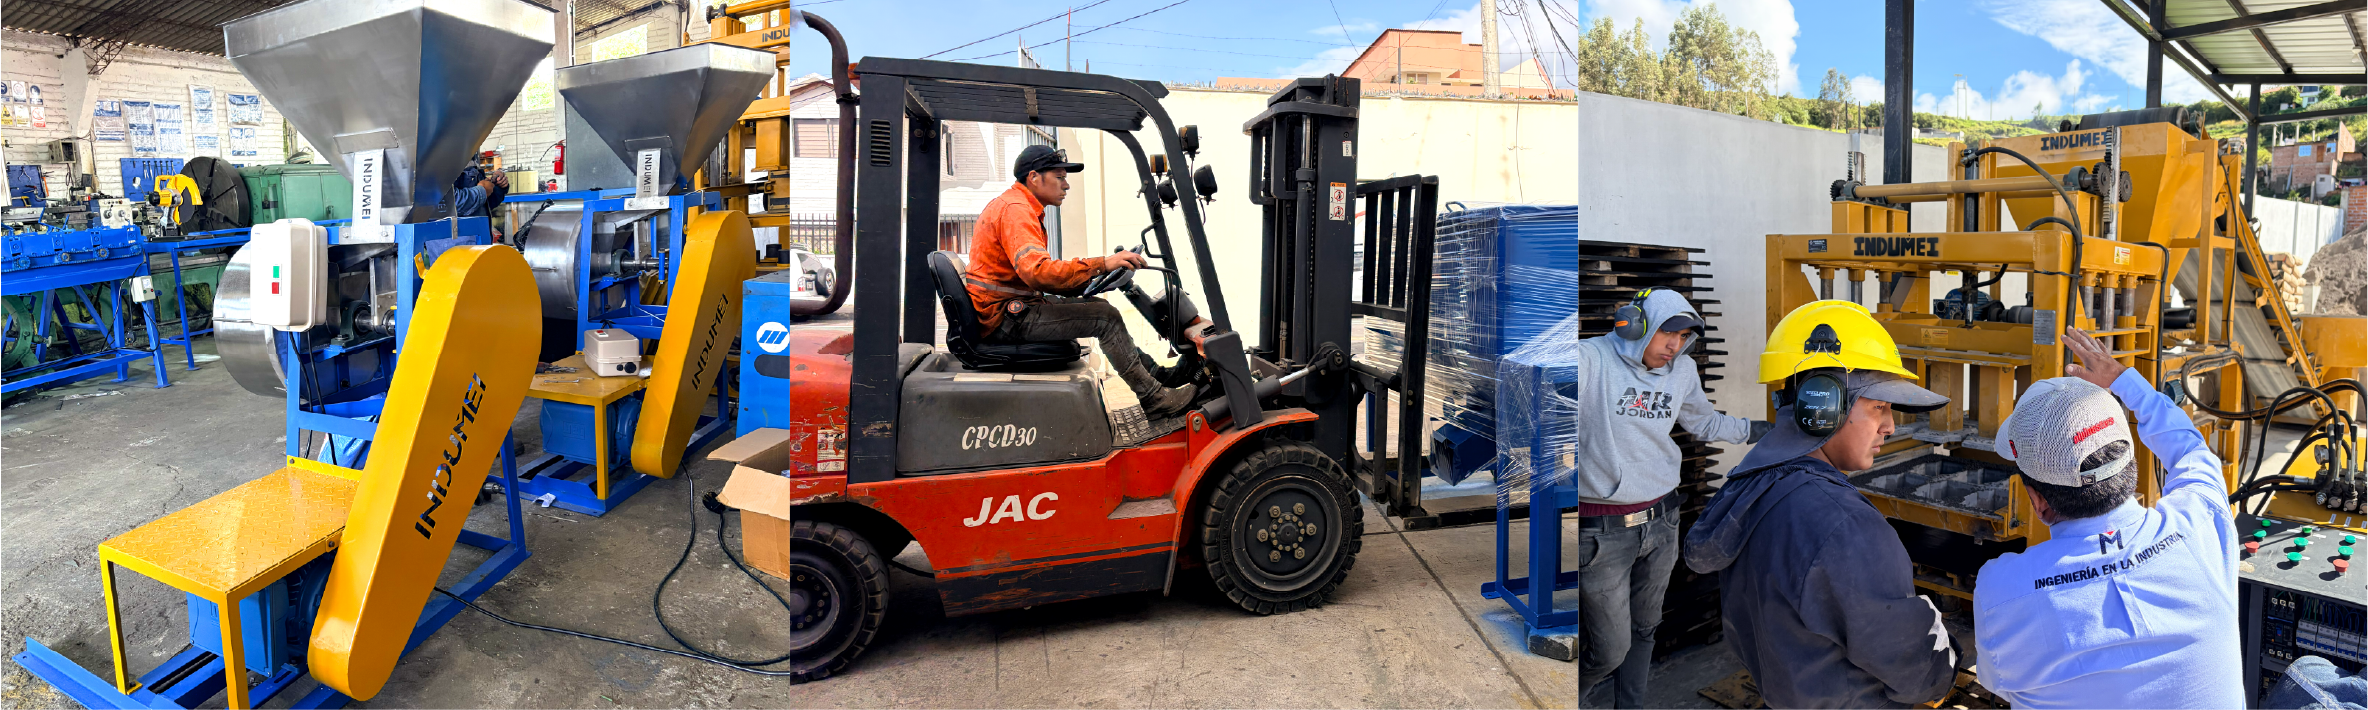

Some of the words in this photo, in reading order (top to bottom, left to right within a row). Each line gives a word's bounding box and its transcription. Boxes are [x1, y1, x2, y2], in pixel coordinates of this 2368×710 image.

[2041, 132, 2107, 151] INDUMEI
[362, 158, 373, 219] INDUMEI
[643, 154, 652, 193] INDUMEI
[1854, 237, 1939, 257] INDUMEI
[692, 293, 728, 391] INDUMEI
[1616, 407, 1671, 419] JORDAN
[1617, 387, 1672, 410] AIR
[962, 424, 1037, 450] CPCD30
[415, 372, 486, 540] INDUMEI
[963, 492, 1058, 527] JAC
[2035, 566, 2099, 589] INGENIERÍA
[2102, 563, 2117, 575] EN
[2120, 558, 2134, 570] LA
[2135, 531, 2184, 563] INDUSTRIA
